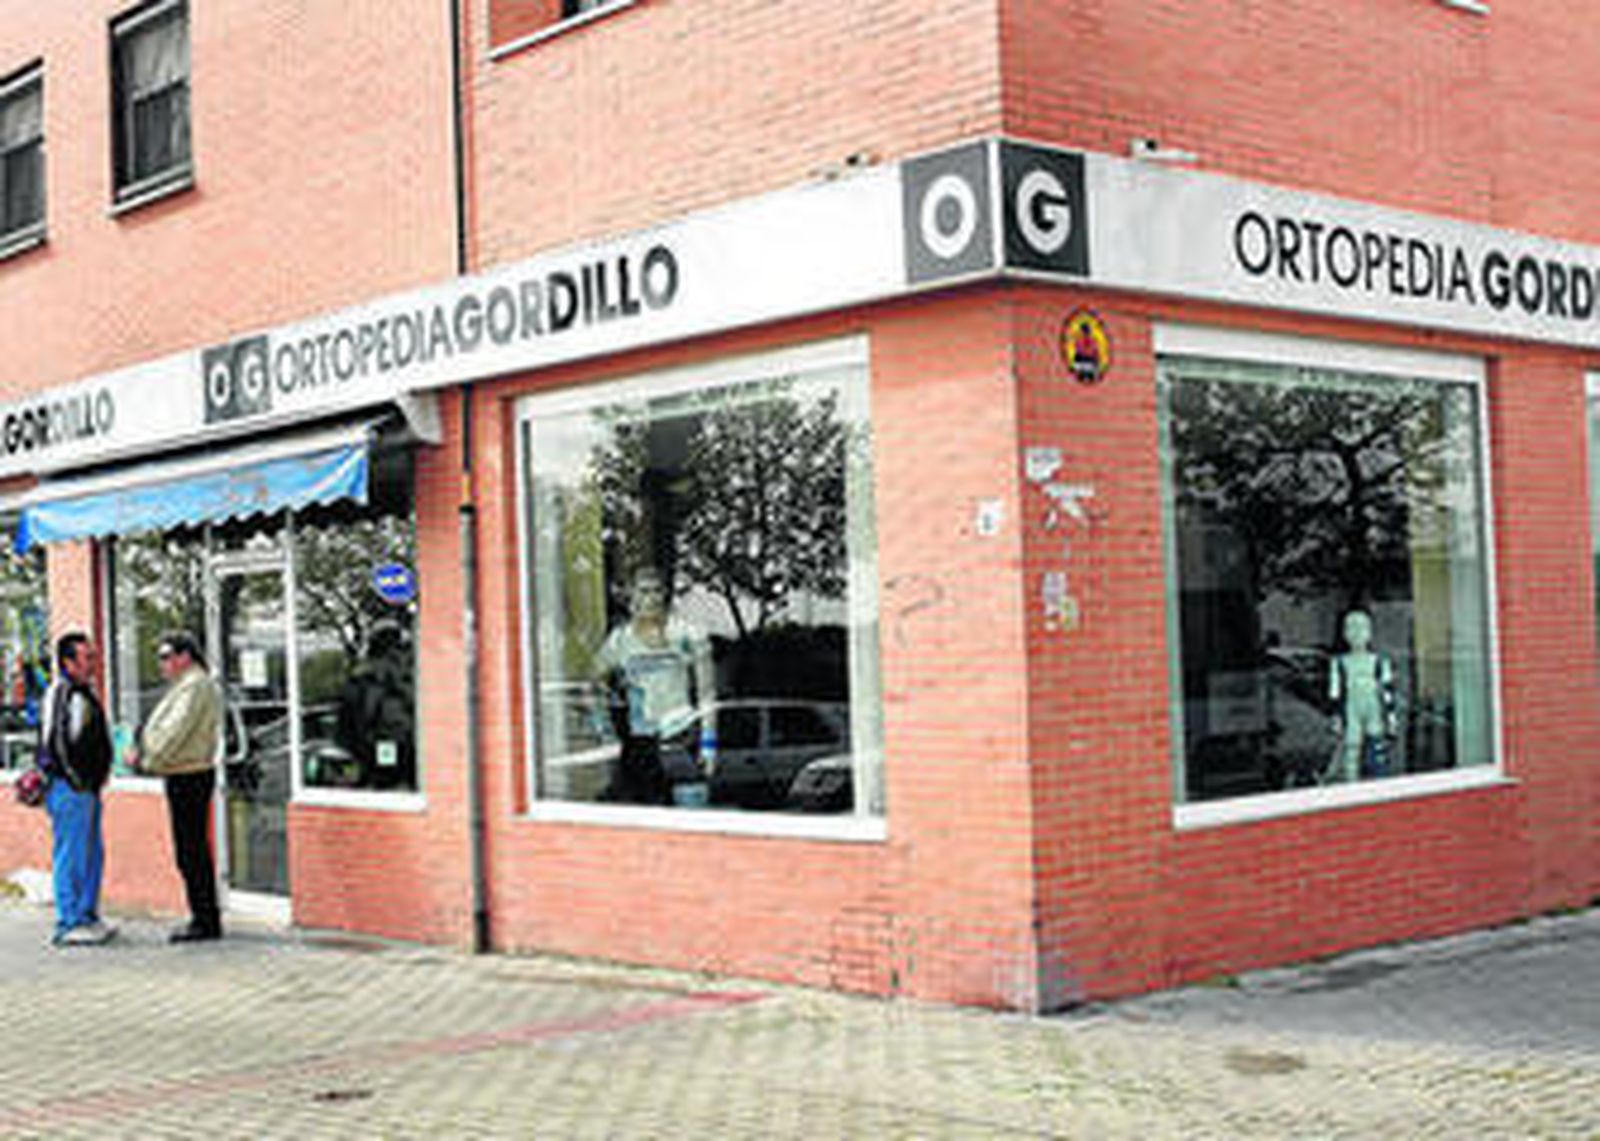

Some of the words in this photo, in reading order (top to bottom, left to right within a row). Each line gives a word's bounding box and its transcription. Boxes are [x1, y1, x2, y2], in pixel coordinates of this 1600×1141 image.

[1016, 169, 1072, 255] G
[1234, 211, 1477, 305] ORTOPEDIA
[1482, 249, 1600, 321] GORD
[0, 387, 116, 456] GORDILLO
